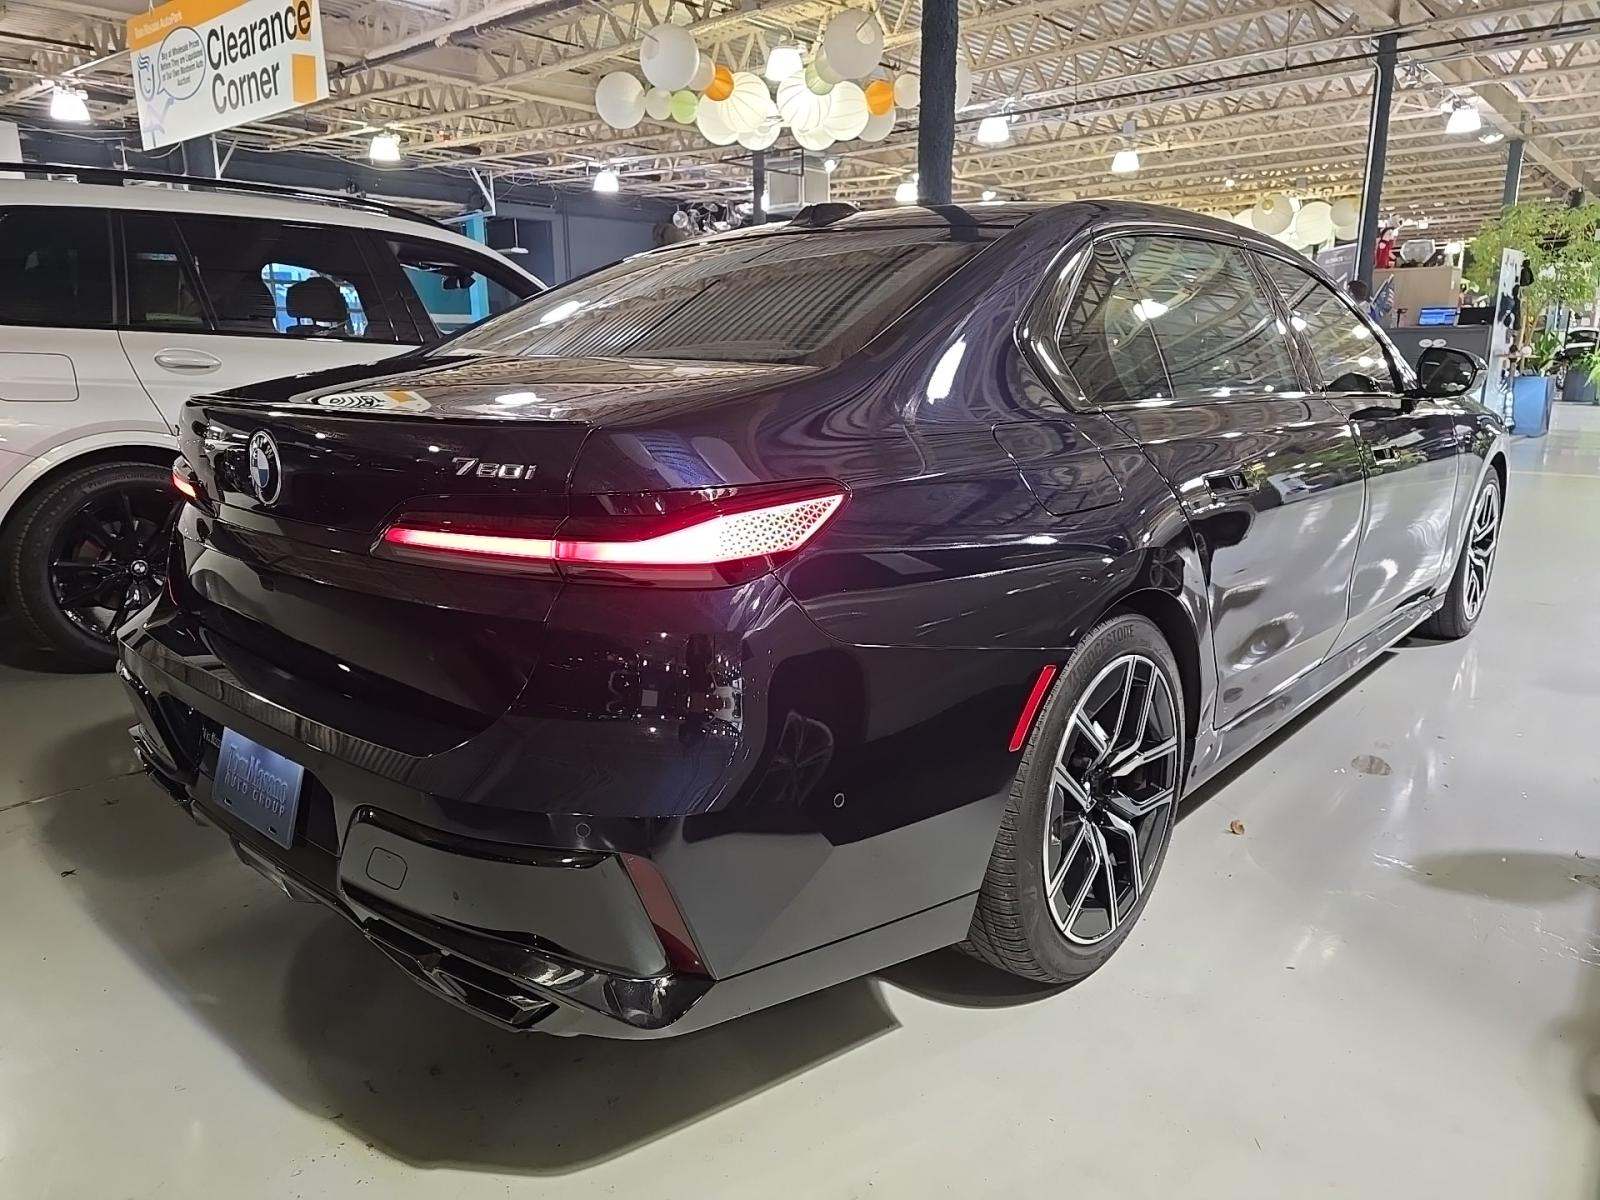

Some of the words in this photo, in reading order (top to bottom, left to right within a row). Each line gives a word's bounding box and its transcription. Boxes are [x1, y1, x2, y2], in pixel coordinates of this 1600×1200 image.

[207, 0, 311, 70] Clearance
[212, 61, 281, 114] Corner
[224, 769, 248, 794] AUTO
[252, 788, 285, 817] GROUP
